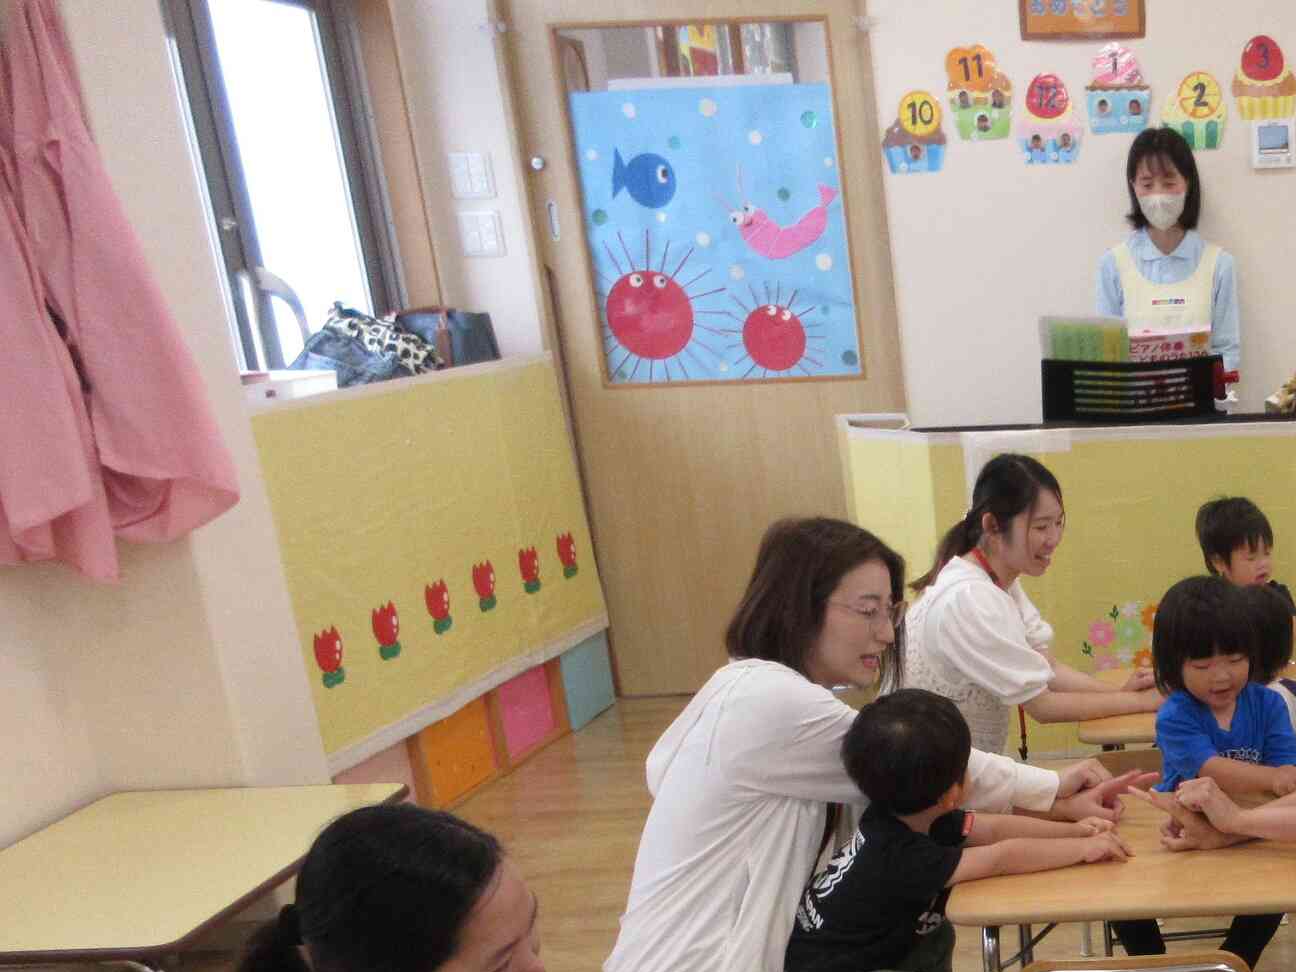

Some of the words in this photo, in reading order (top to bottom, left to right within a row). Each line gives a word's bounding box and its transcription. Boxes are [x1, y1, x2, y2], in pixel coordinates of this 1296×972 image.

[958, 54, 984, 81] 11
[1109, 52, 1118, 76] 1
[1256, 43, 1269, 69] 3
[1036, 84, 1057, 109] 12
[1192, 82, 1208, 107] 2
[906, 100, 934, 126] 10
